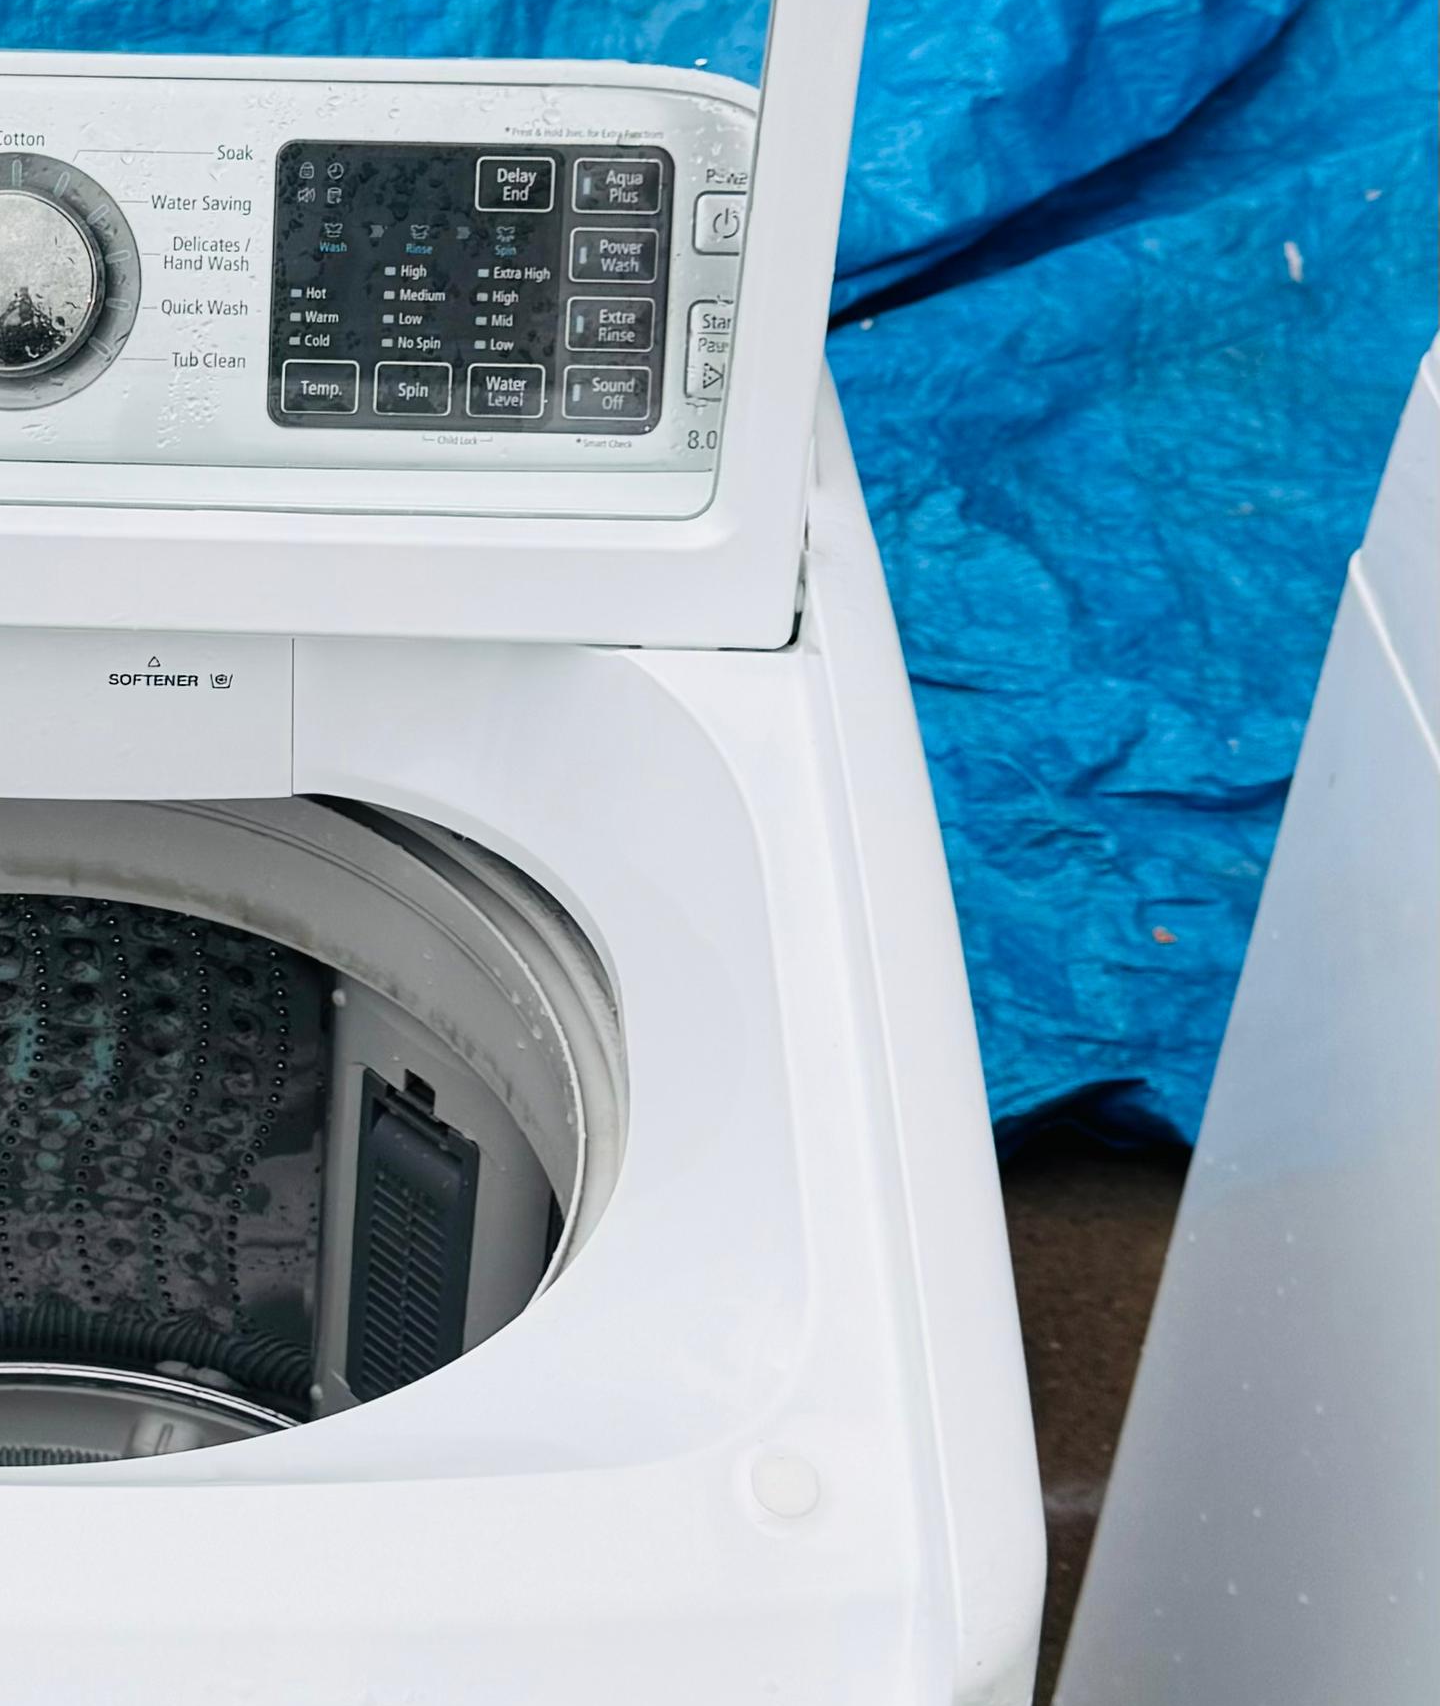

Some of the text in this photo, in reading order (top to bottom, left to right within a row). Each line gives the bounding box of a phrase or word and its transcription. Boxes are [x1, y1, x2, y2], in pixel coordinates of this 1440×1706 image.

[217, 144, 254, 161] Soak
[497, 168, 537, 186] Delay
[606, 169, 643, 186] Aqua
[503, 186, 529, 201] End
[610, 188, 639, 203] Plus
[151, 194, 252, 216] Water Saving
[173, 236, 240, 253] Delicates
[319, 241, 347, 253] Wash
[406, 243, 433, 255] Rinse
[495, 245, 517, 258] Spin
[599, 239, 643, 255] Power
[163, 254, 249, 272] Hand Wash
[601, 257, 639, 273] Wash
[401, 264, 427, 280] High
[493, 266, 551, 282] Extra High
[306, 287, 327, 299] Hot
[400, 289, 446, 302] Medium
[492, 291, 519, 306] High
[161, 300, 249, 317] Quick Wash
[305, 311, 339, 323] Warm
[398, 313, 423, 325] Low
[491, 314, 513, 327] Mid
[599, 309, 636, 324] Extra
[702, 313, 731, 329] Star
[304, 334, 330, 347] Cold
[598, 327, 635, 342] Rinse
[398, 336, 441, 351] No Spin
[490, 338, 514, 351] Low
[172, 352, 246, 369] Tub Clean
[300, 380, 342, 399] Temp.
[398, 382, 429, 400] Spin
[486, 376, 527, 391] Water
[592, 377, 635, 393] Sound
[488, 392, 523, 407] Level
[602, 396, 624, 410] Off
[687, 430, 718, 450] 8.0
[108, 673, 199, 688] SOFTENER
